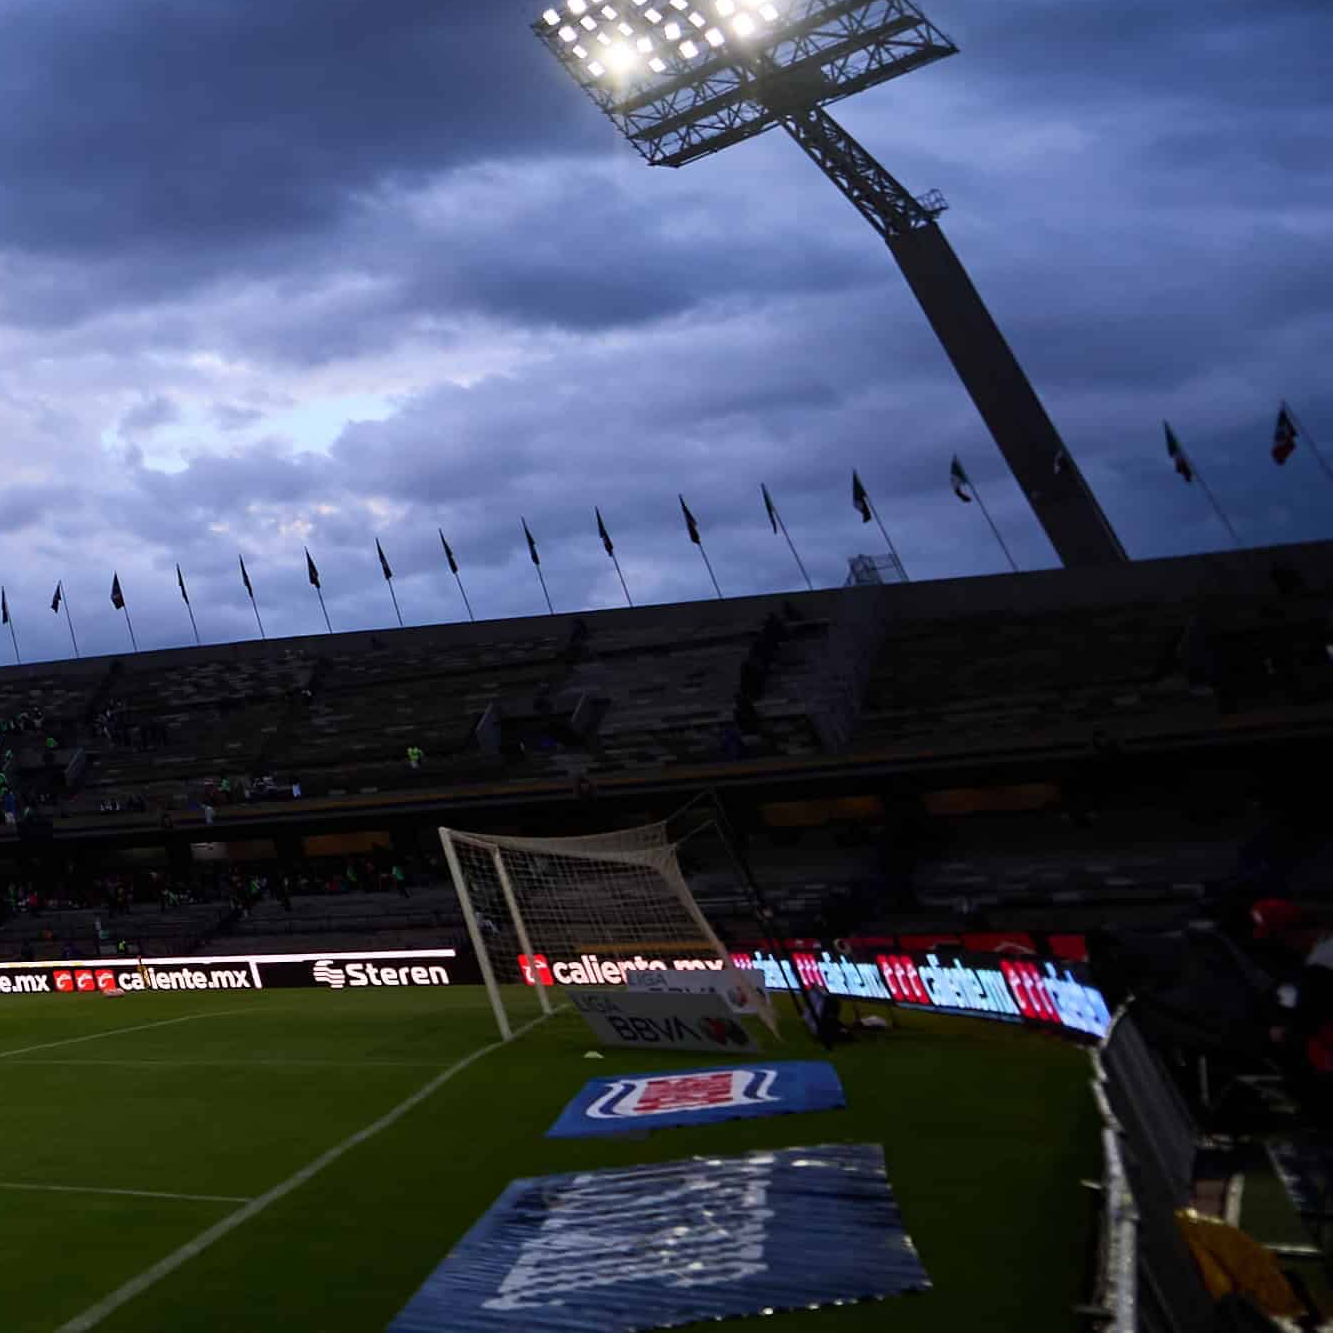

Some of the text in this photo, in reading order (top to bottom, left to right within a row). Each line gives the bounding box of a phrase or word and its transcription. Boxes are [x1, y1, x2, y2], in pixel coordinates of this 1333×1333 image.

[118, 968, 251, 990] caiente.mx
[345, 963, 450, 986] Steren
[607, 1016, 703, 1043] BBVA
